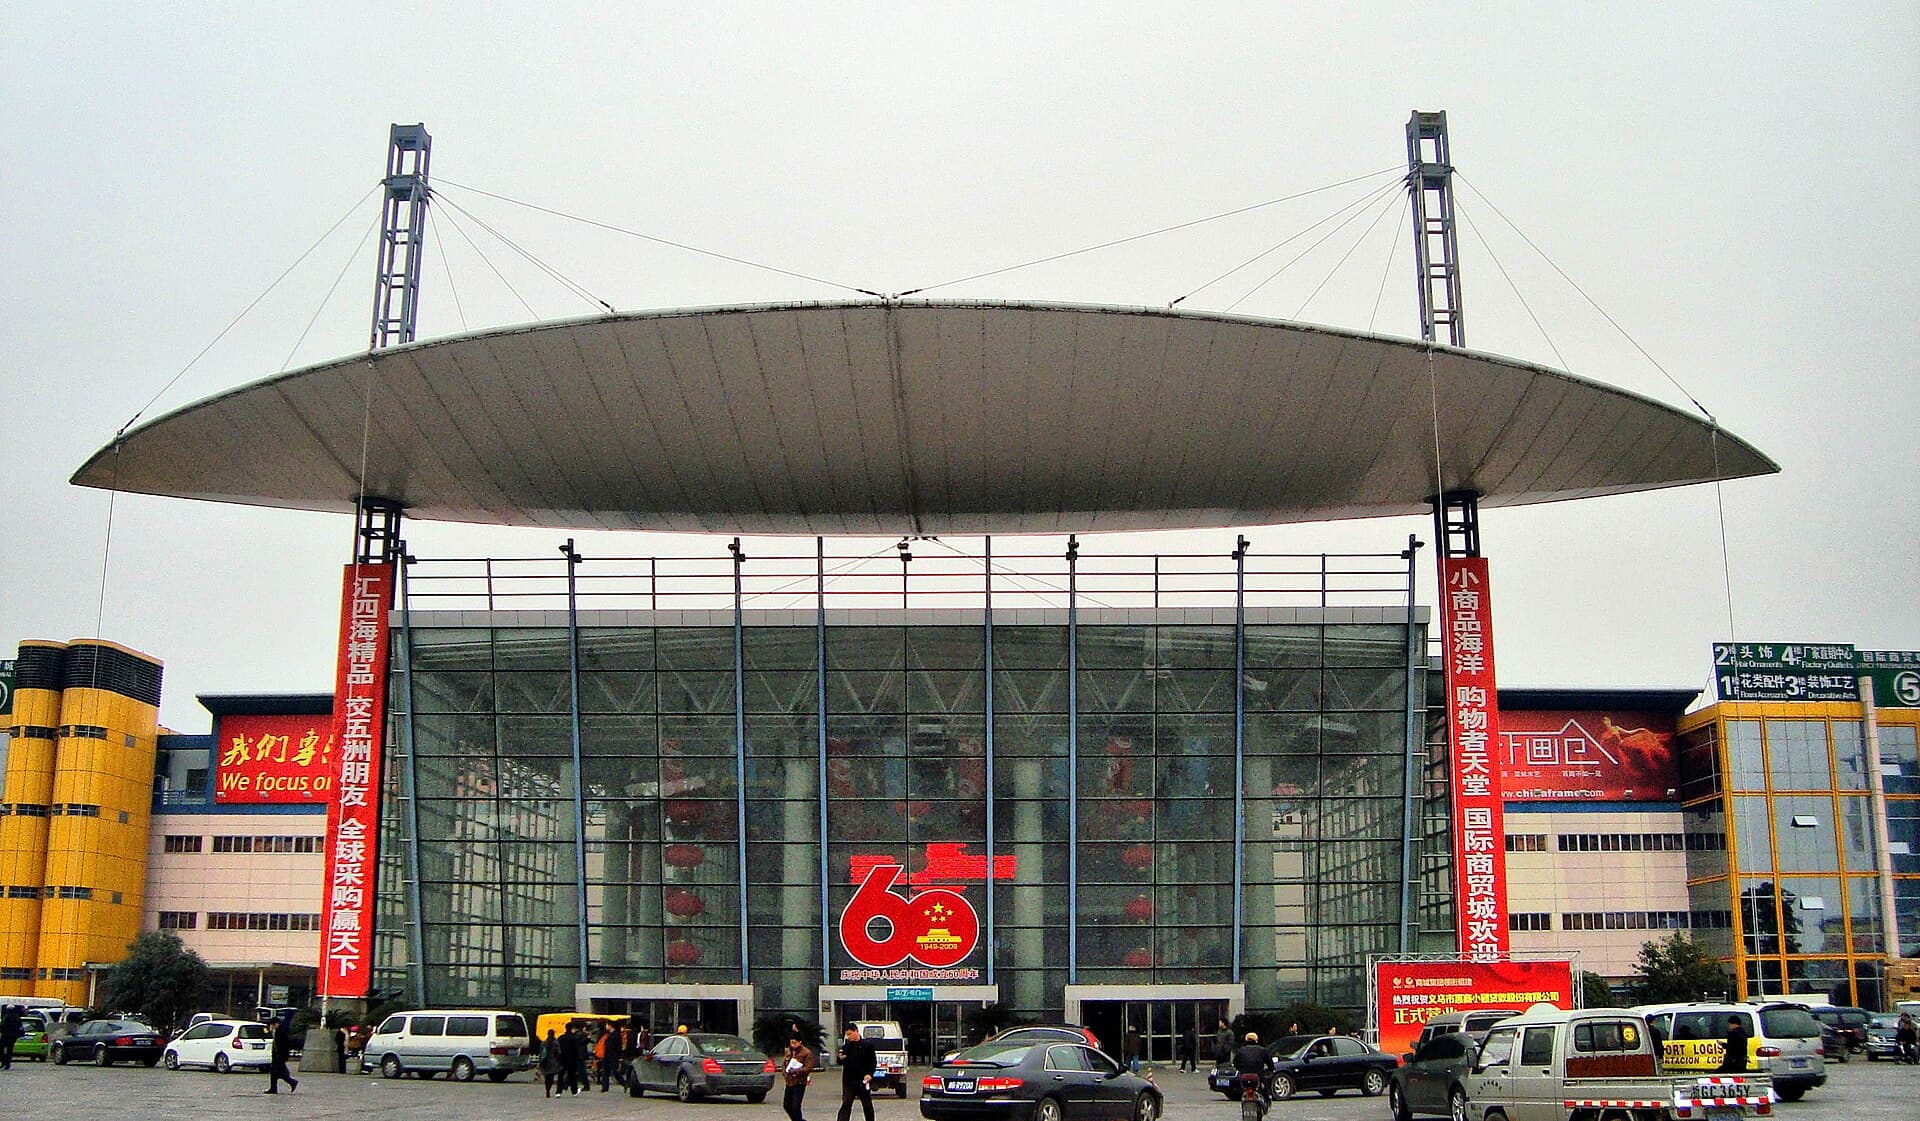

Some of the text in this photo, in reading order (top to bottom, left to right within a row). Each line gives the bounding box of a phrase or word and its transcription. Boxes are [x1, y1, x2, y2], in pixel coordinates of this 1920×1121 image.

[1714, 646, 1730, 666] 2
[1740, 645, 1773, 659] 头饰
[1781, 646, 1797, 666] 4
[1802, 646, 1853, 660] 厂家直销中心
[1801, 661, 1827, 669] Factory
[1863, 652, 1920, 662] 国际商贸
[1720, 675, 1732, 695] 1
[1740, 673, 1785, 689] 花类配件
[1785, 675, 1799, 696] 3
[1807, 675, 1854, 689] 装饰工艺
[1450, 567, 1499, 963] 小商品海洋 购物者天堂 国际商贸城欢迎
[222, 772, 250, 791] We
[255, 771, 309, 791] focus
[330, 577, 381, 977] 汇四海精品 交五洲朋友 全球采购赢天下
[840, 864, 980, 968] 60
[919, 943, 958, 951] 1949-2009
[840, 969, 979, 980] 庆祝中华人民共和国成立60周年
[1664, 1044, 1686, 1055] ORT
